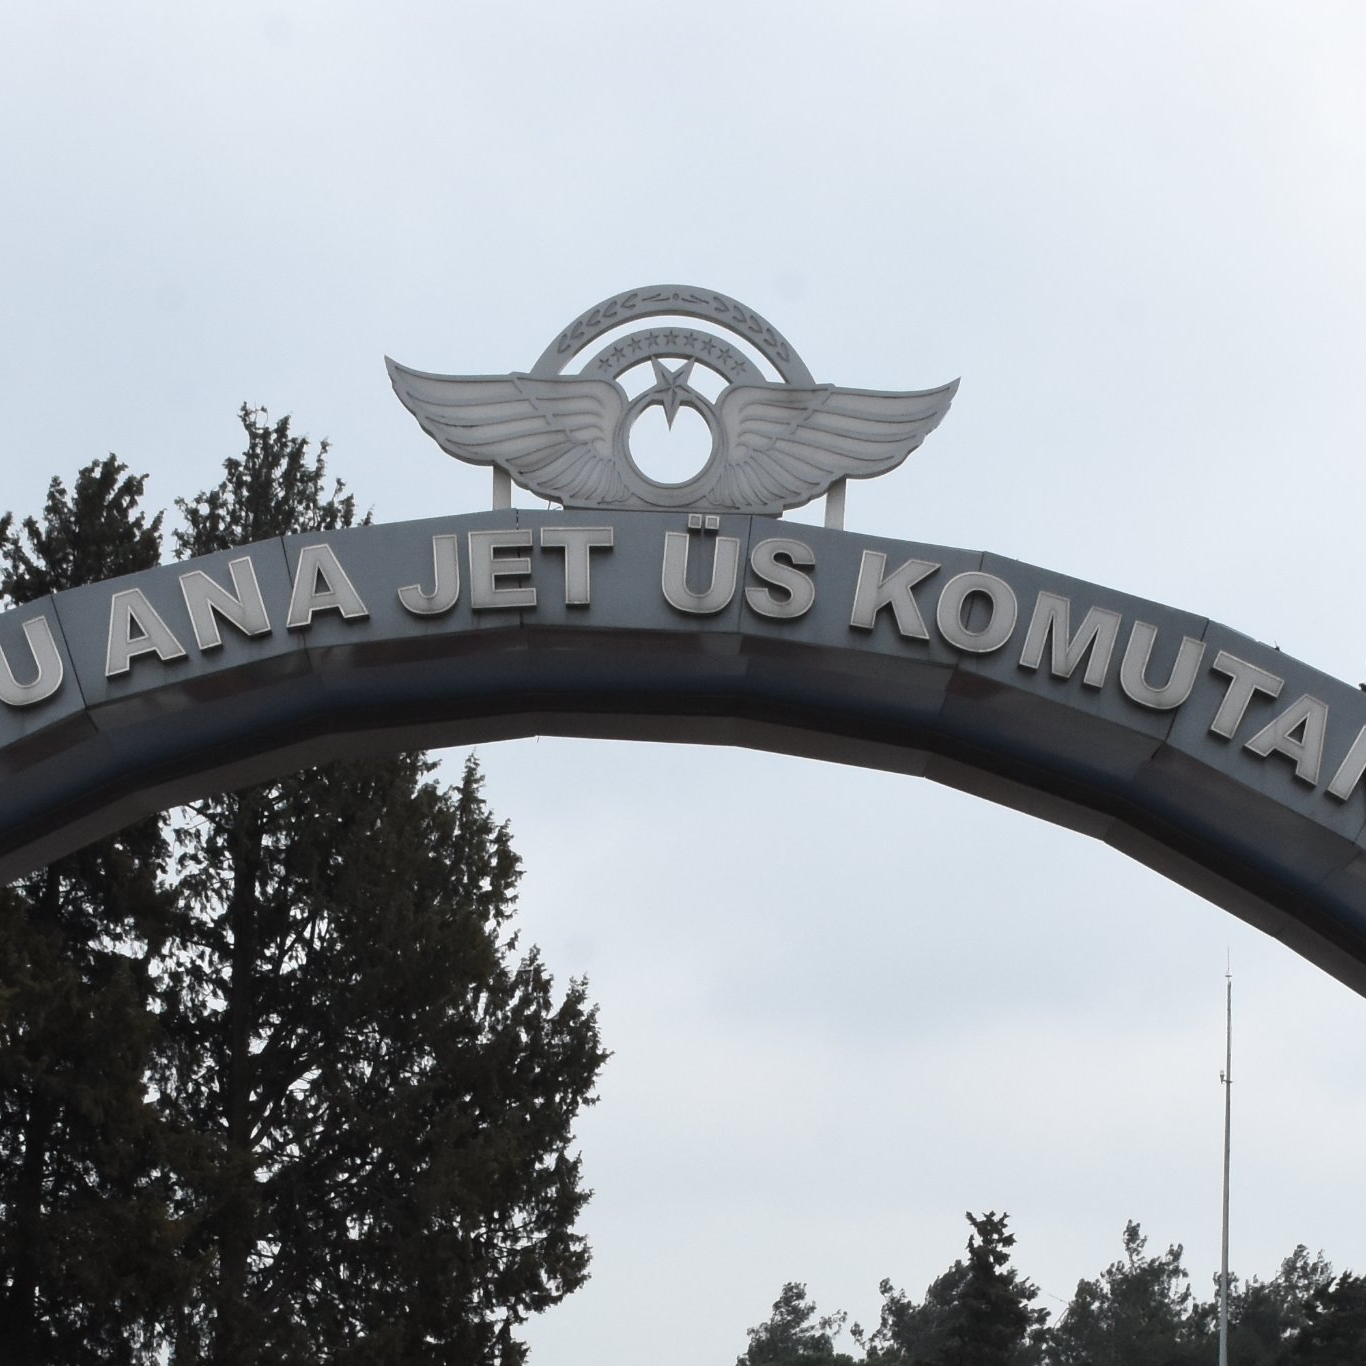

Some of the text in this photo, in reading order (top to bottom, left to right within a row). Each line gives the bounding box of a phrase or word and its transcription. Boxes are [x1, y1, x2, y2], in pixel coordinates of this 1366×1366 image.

[104, 542, 370, 678] ANA
[398, 526, 614, 615] JET
[661, 514, 816, 619] ÜS
